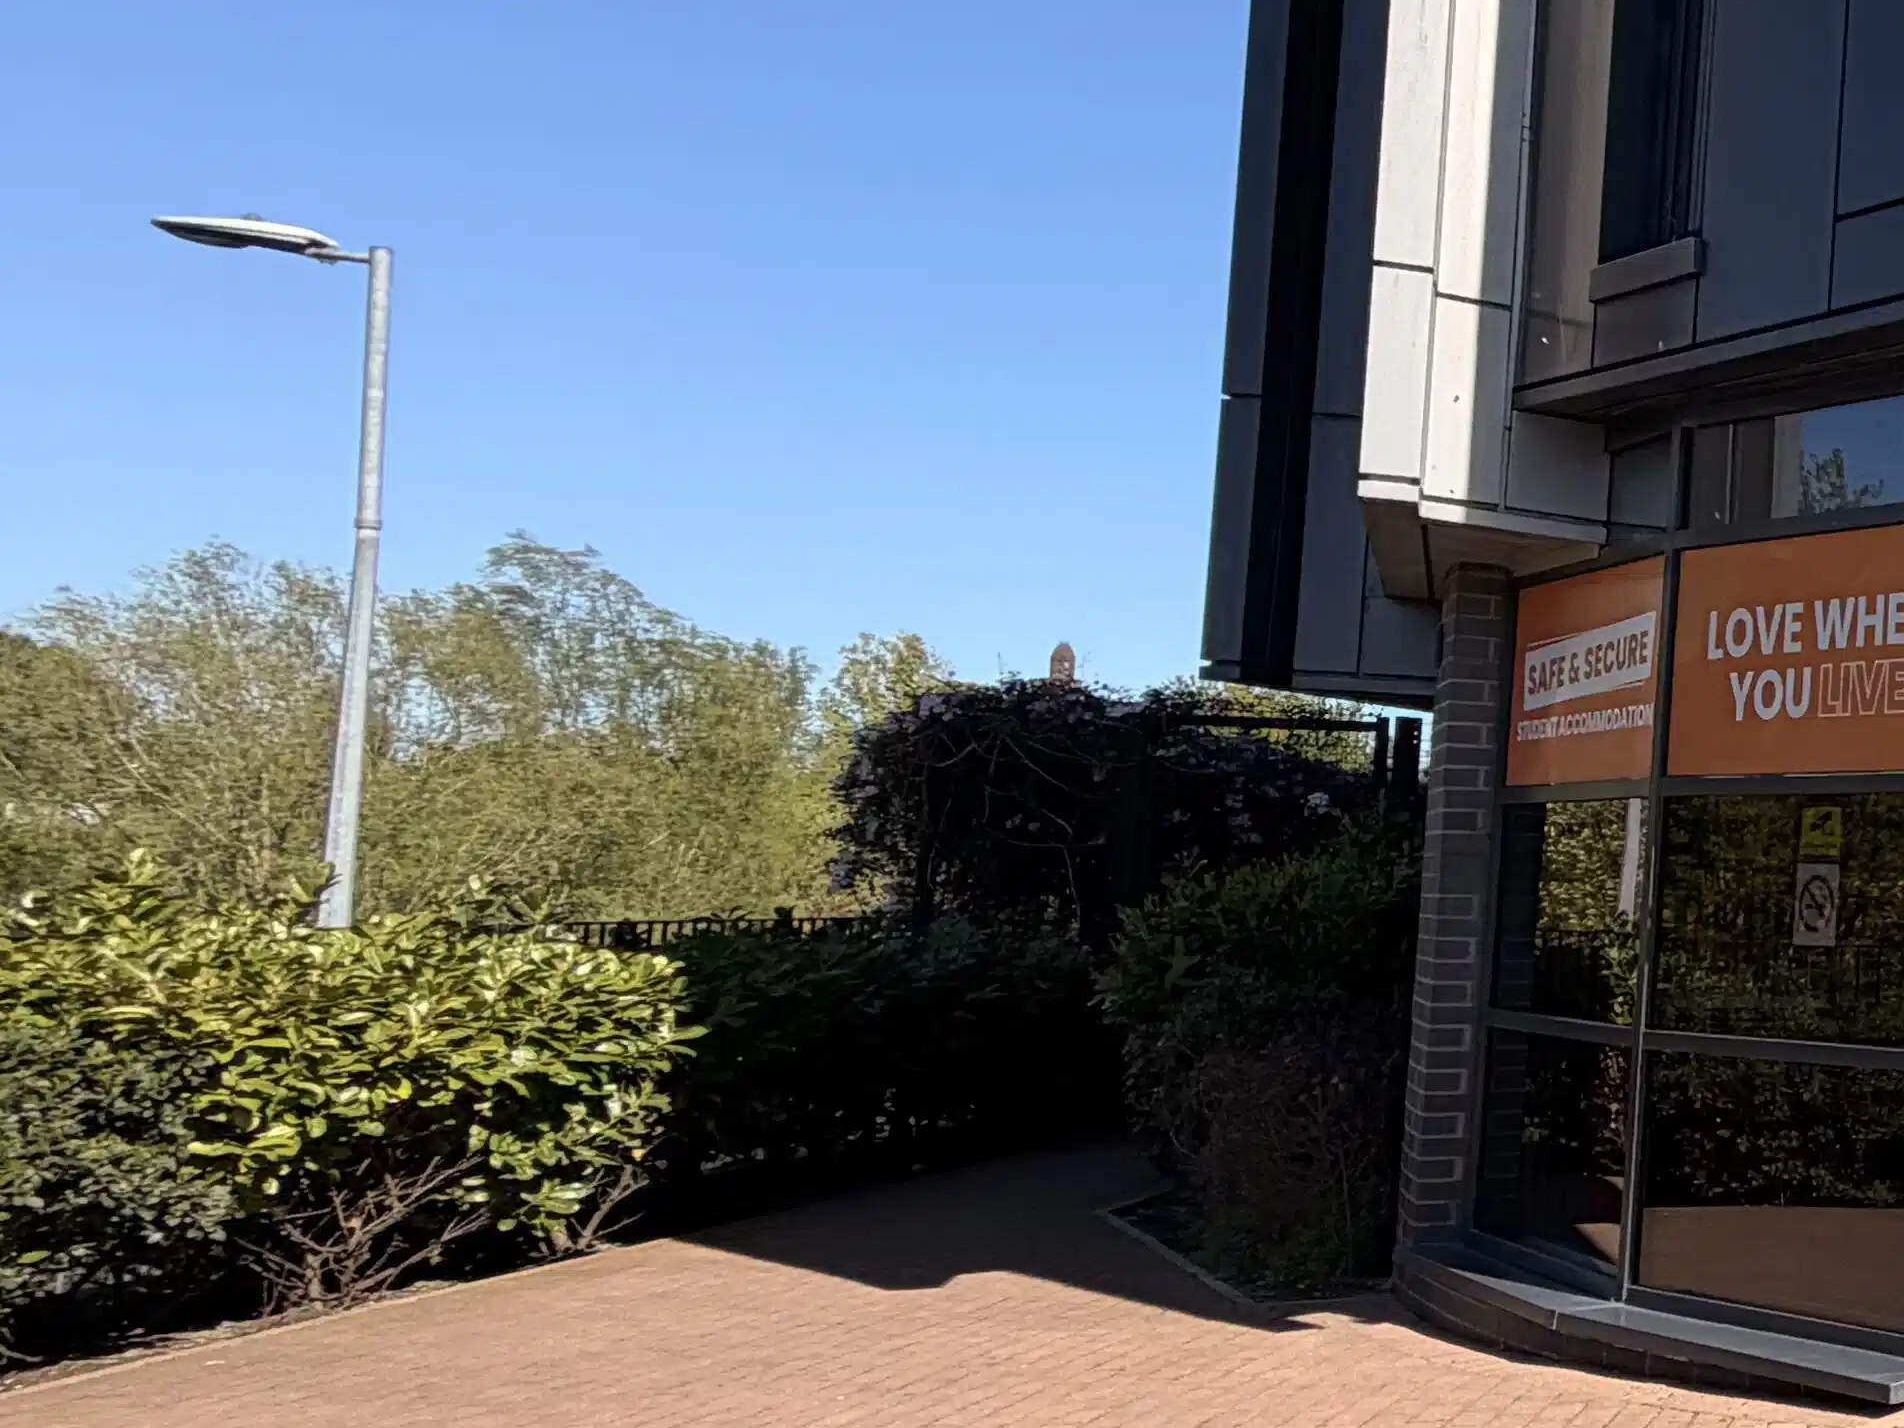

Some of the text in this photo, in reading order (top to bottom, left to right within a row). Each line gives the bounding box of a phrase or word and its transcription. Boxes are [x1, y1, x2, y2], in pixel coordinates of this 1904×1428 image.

[1707, 601, 1805, 660] LOVE
[1527, 629, 1649, 696] SAFE & SECURE
[1729, 665, 1813, 722] YOU
